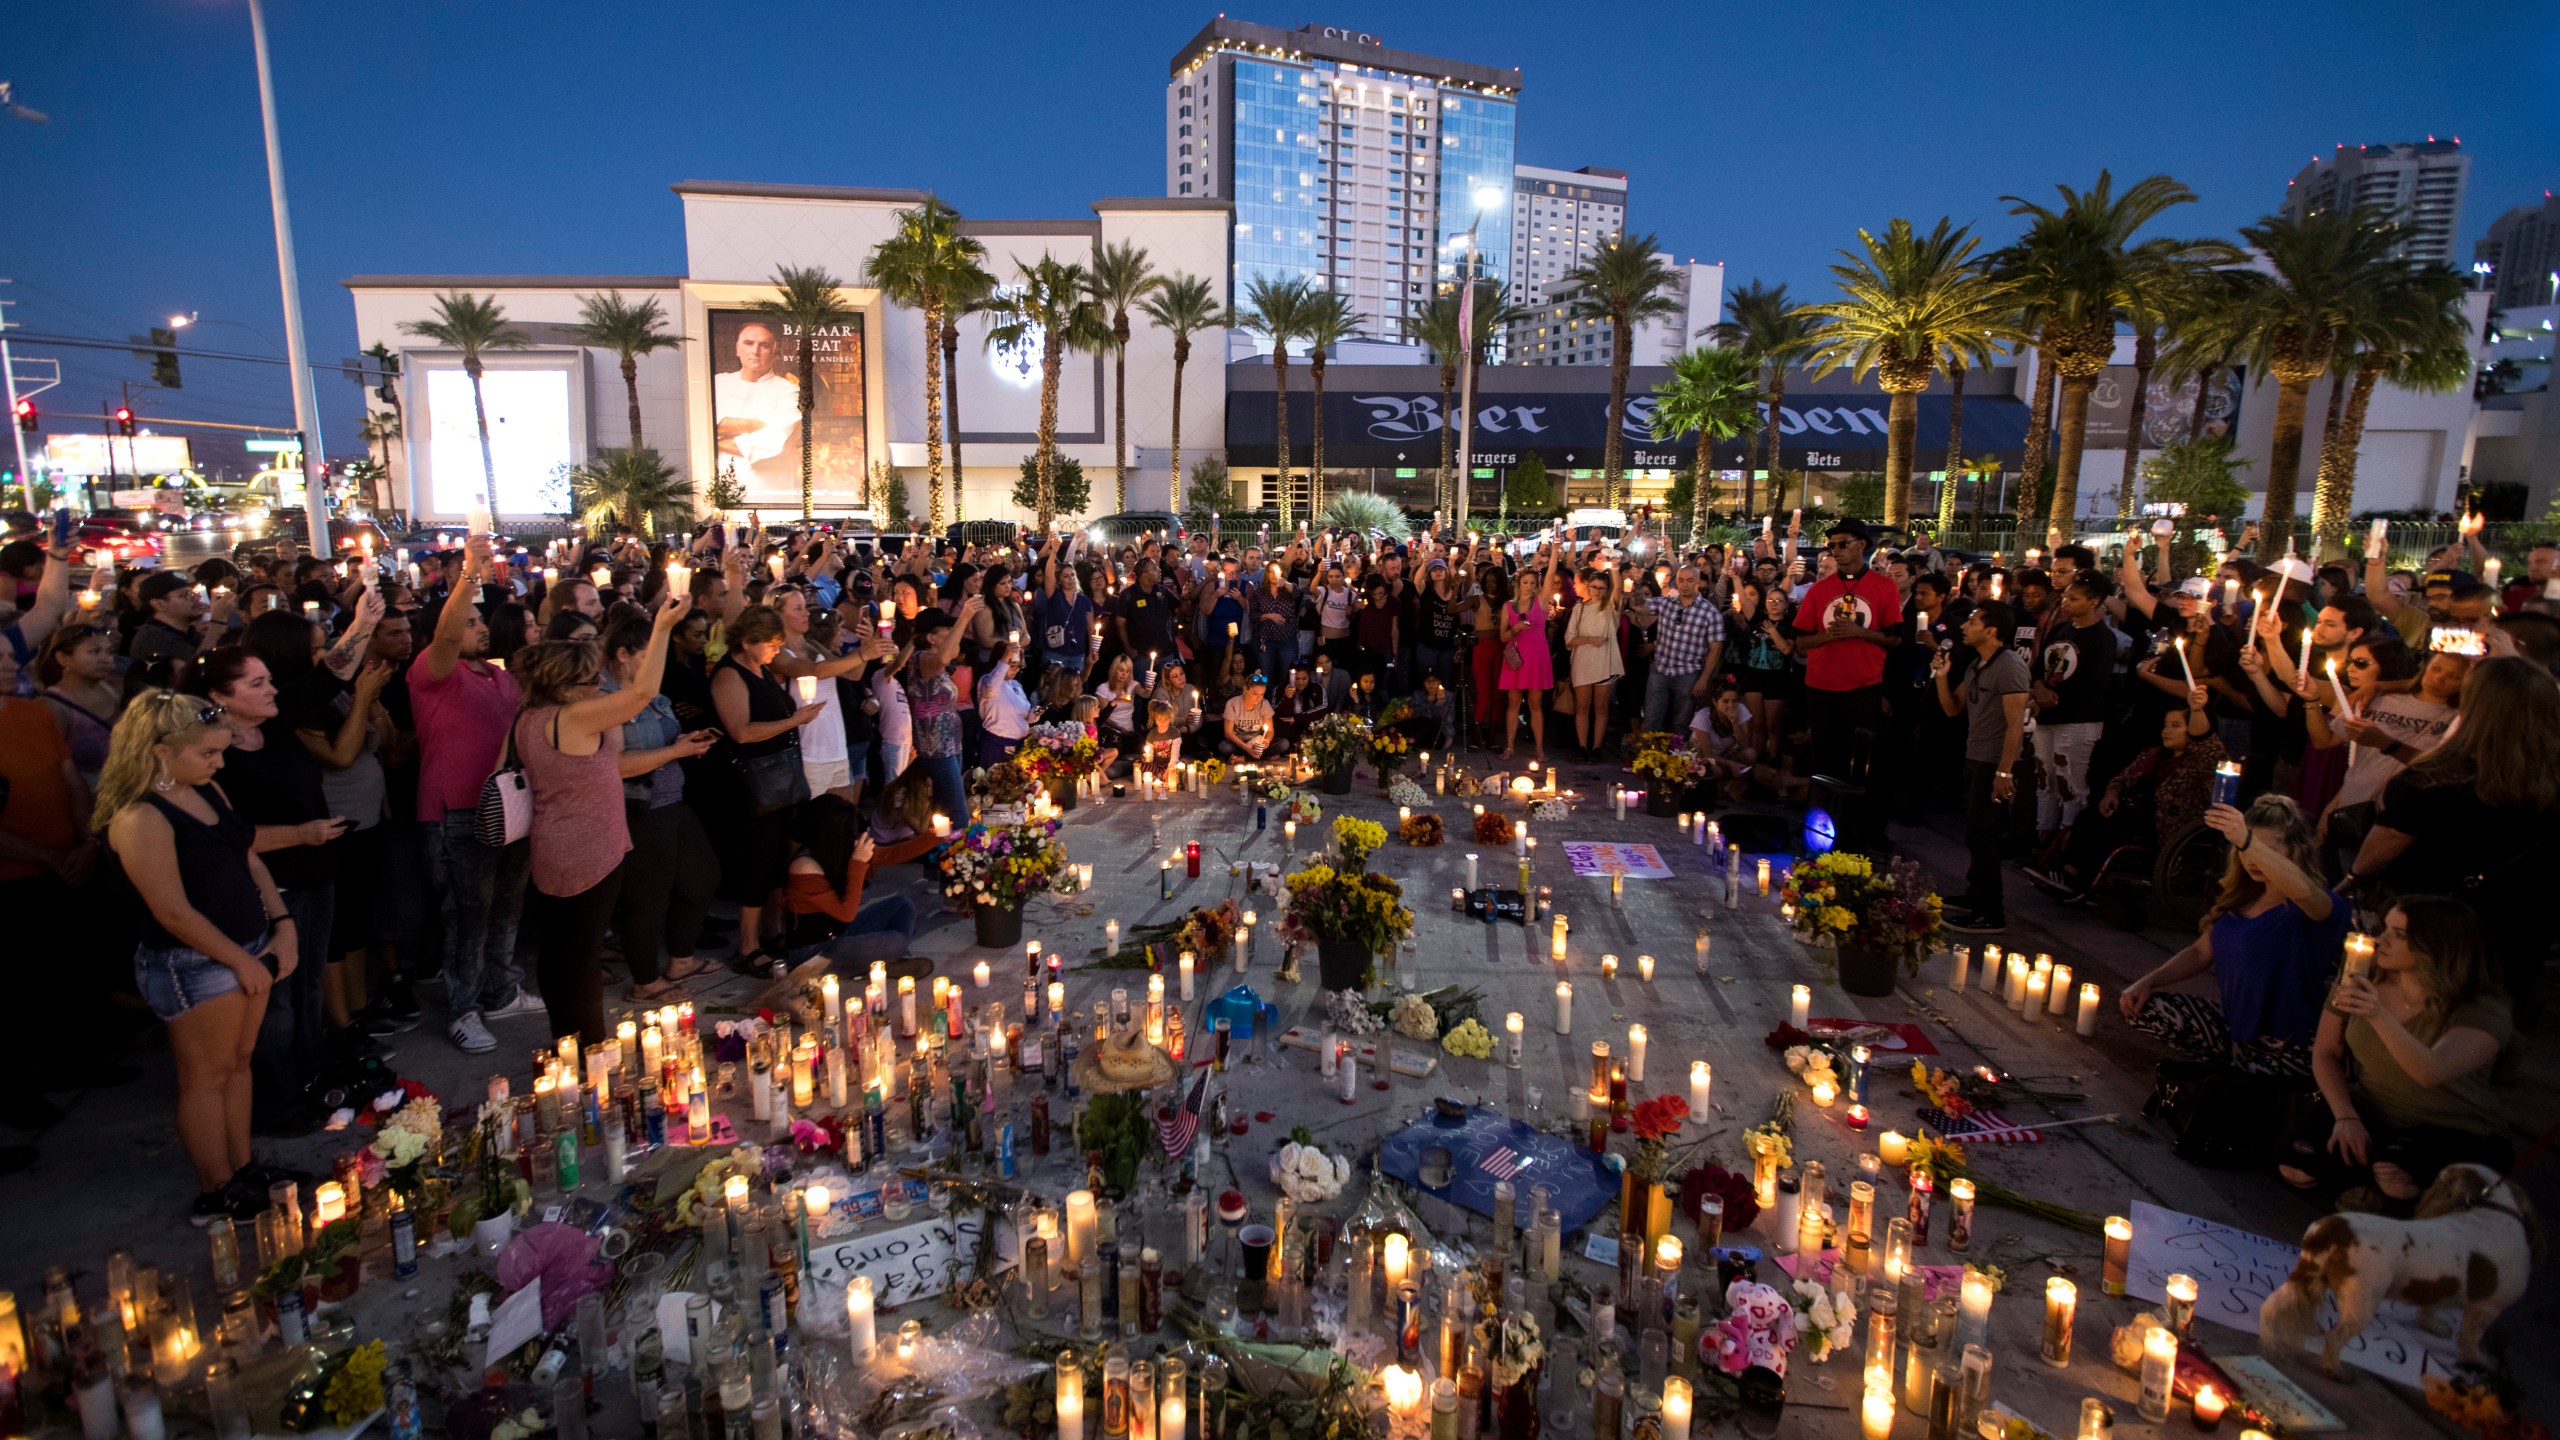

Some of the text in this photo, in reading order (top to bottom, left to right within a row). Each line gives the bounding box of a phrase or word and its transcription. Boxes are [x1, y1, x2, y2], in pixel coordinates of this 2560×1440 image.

[1634, 451, 1677, 466] Beers
[1806, 451, 1841, 467] Bets
[1565, 845, 1600, 875] VEGAS
